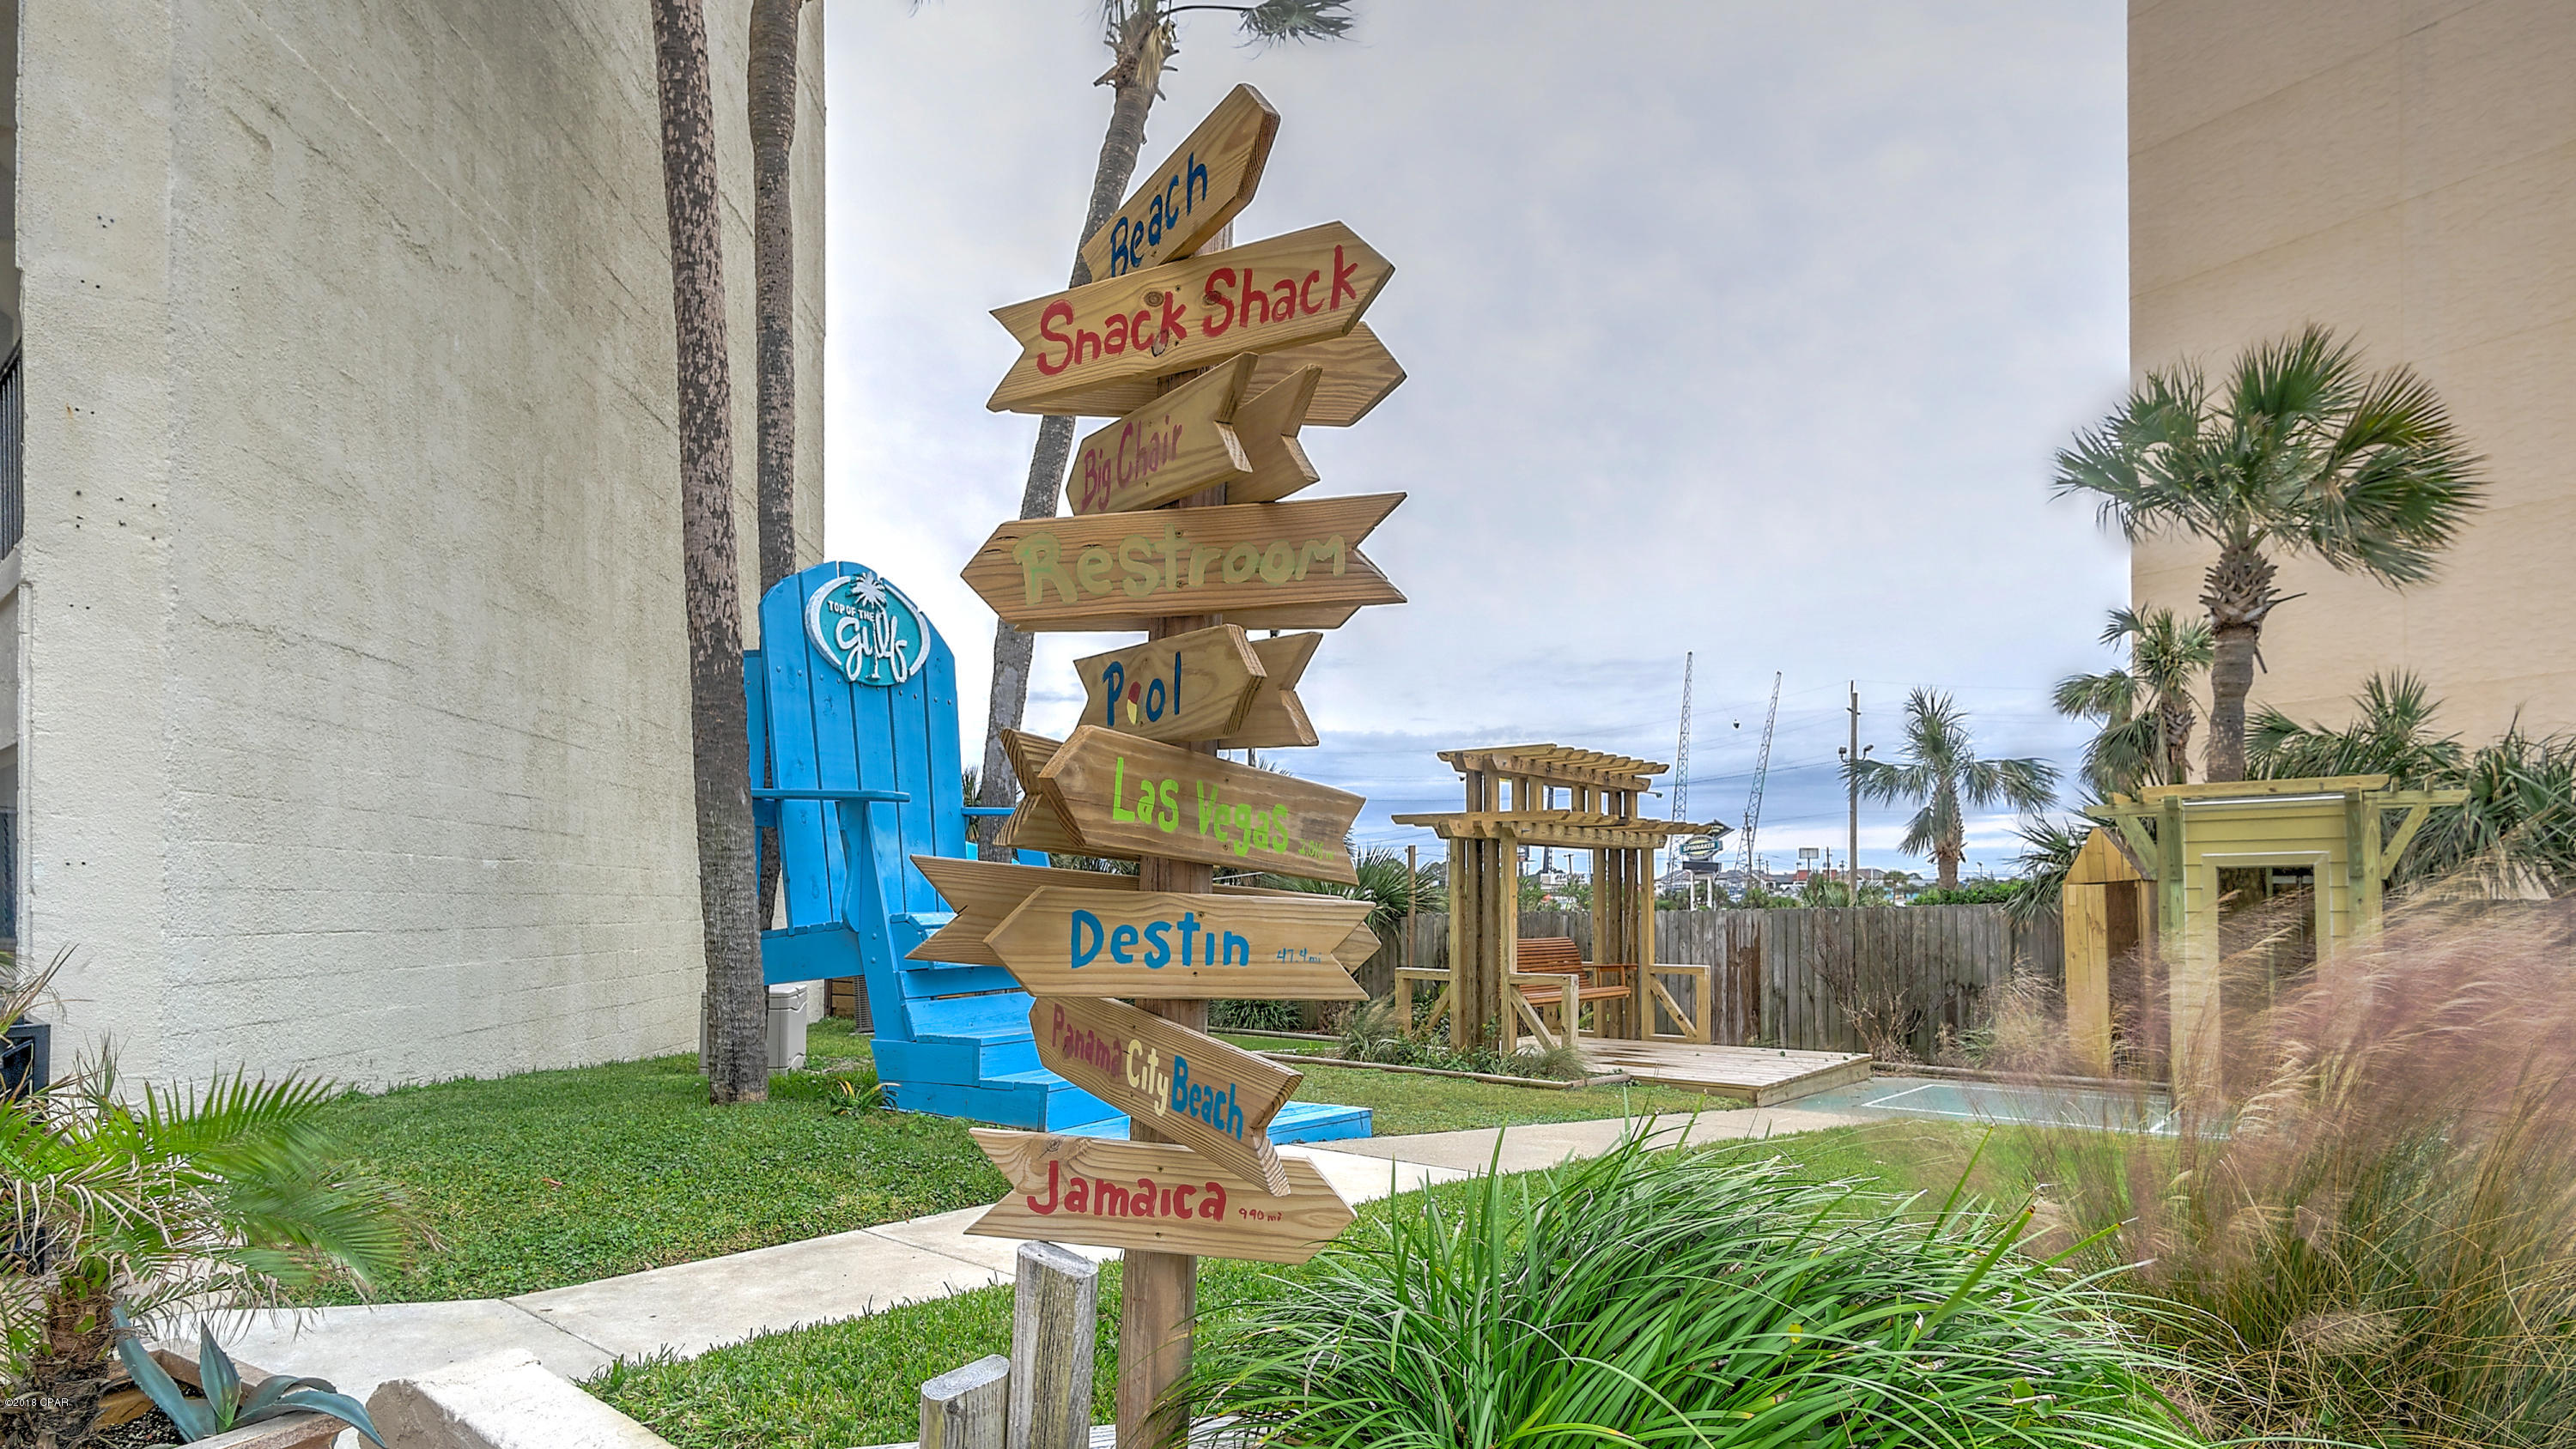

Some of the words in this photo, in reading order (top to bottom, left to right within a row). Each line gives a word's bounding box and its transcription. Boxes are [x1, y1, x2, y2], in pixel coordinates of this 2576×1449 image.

[1110, 152, 1208, 277] Beach
[1036, 291, 1188, 376] Snack
[1201, 245, 1358, 337] Shack
[1080, 448, 1111, 512] Big
[1117, 414, 1182, 489] Chair
[828, 601, 845, 614] TOP
[846, 605, 856, 616] OF
[858, 609, 875, 621] THE
[1103, 651, 1182, 727] Pool
[1112, 756, 1180, 833] Las
[1197, 779, 1289, 857] Vegas
[1683, 842, 1716, 852] SPINNAKER
[1071, 909, 1249, 968] Destin
[1052, 1003, 1122, 1078] Panama
[1127, 1040, 1169, 1116] City
[1171, 1055, 1243, 1141] Beach
[1027, 1161, 1226, 1222] Jamaica
[1238, 1207, 1264, 1221] 990
